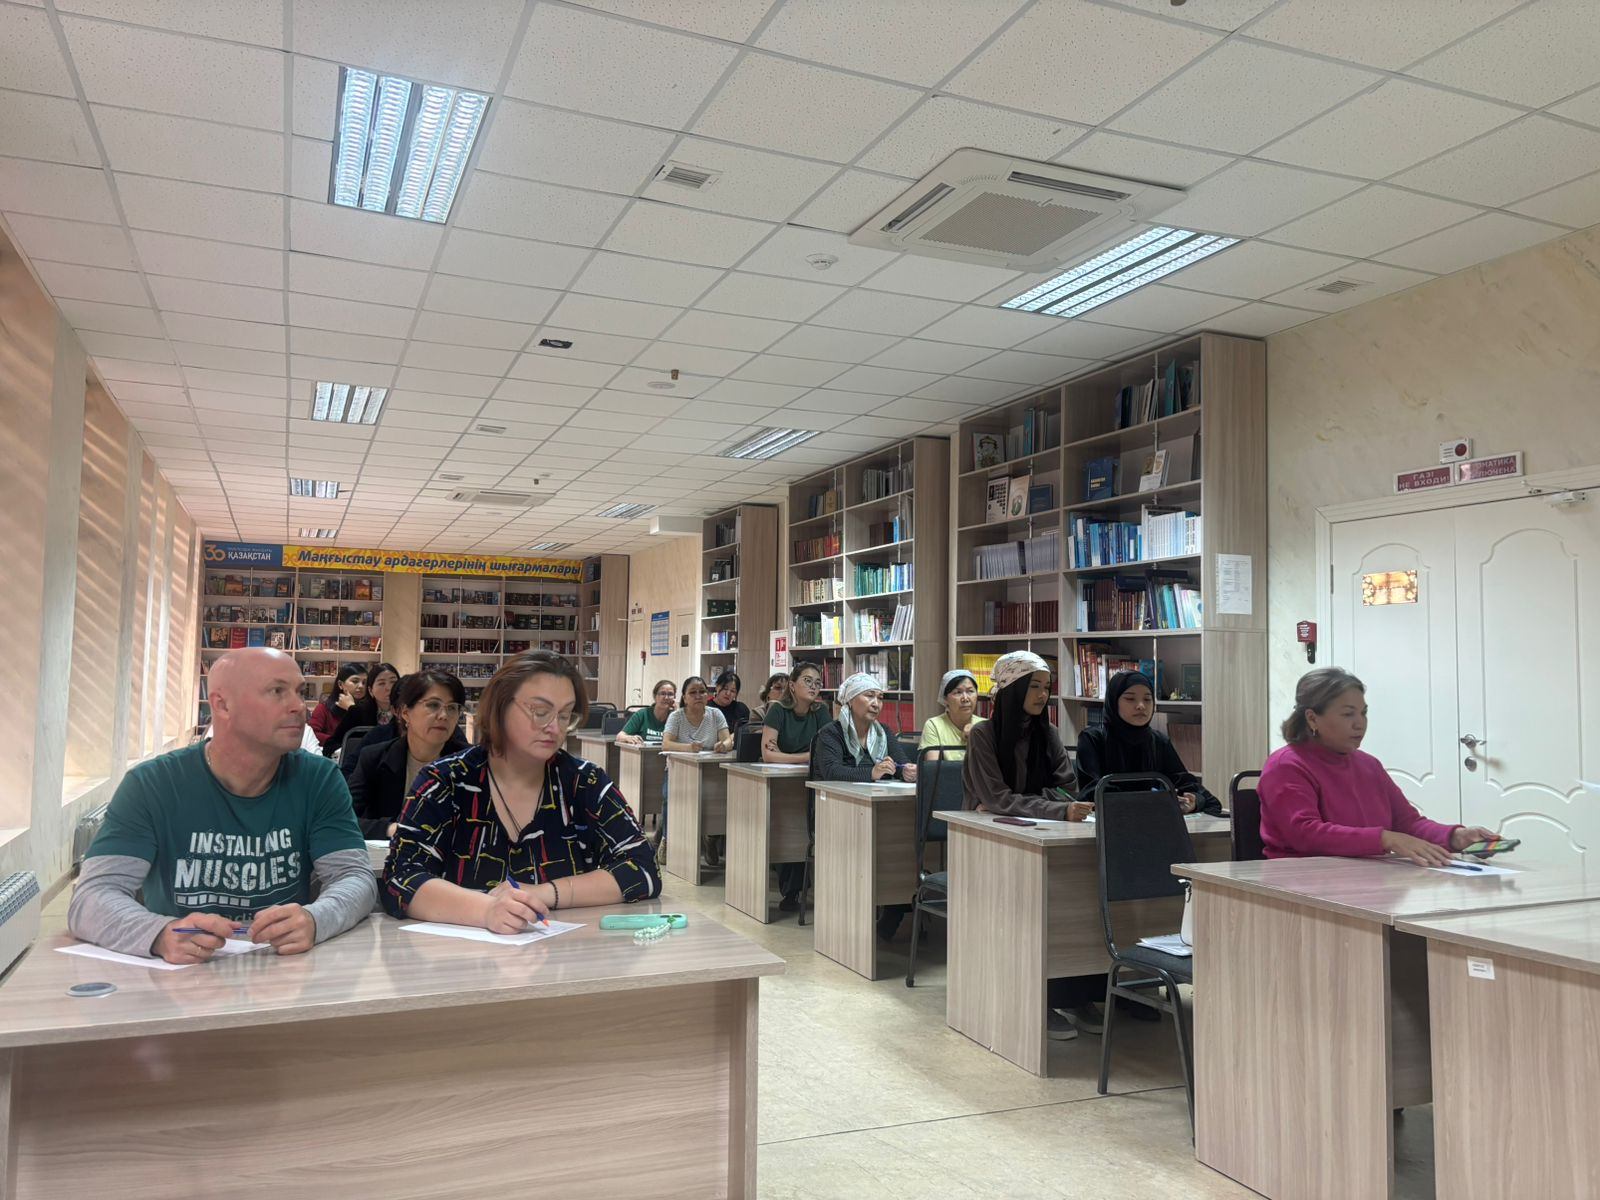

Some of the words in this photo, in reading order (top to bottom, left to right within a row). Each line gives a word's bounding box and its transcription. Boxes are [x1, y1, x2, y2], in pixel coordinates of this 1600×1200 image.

[1399, 481, 1411, 489] НЕ
[1414, 475, 1450, 487] ВХОДИ!
[1413, 471, 1434, 480] ГАЗ!
[228, 551, 271, 561] ҚАЗАҚСТАН
[298, 551, 382, 568] Маңғыстау
[384, 555, 486, 571] ардагерлерінің
[490, 562, 581, 576] шығармалары
[189, 828, 292, 857] INSTALLNG
[174, 851, 300, 891] MUSCLES
